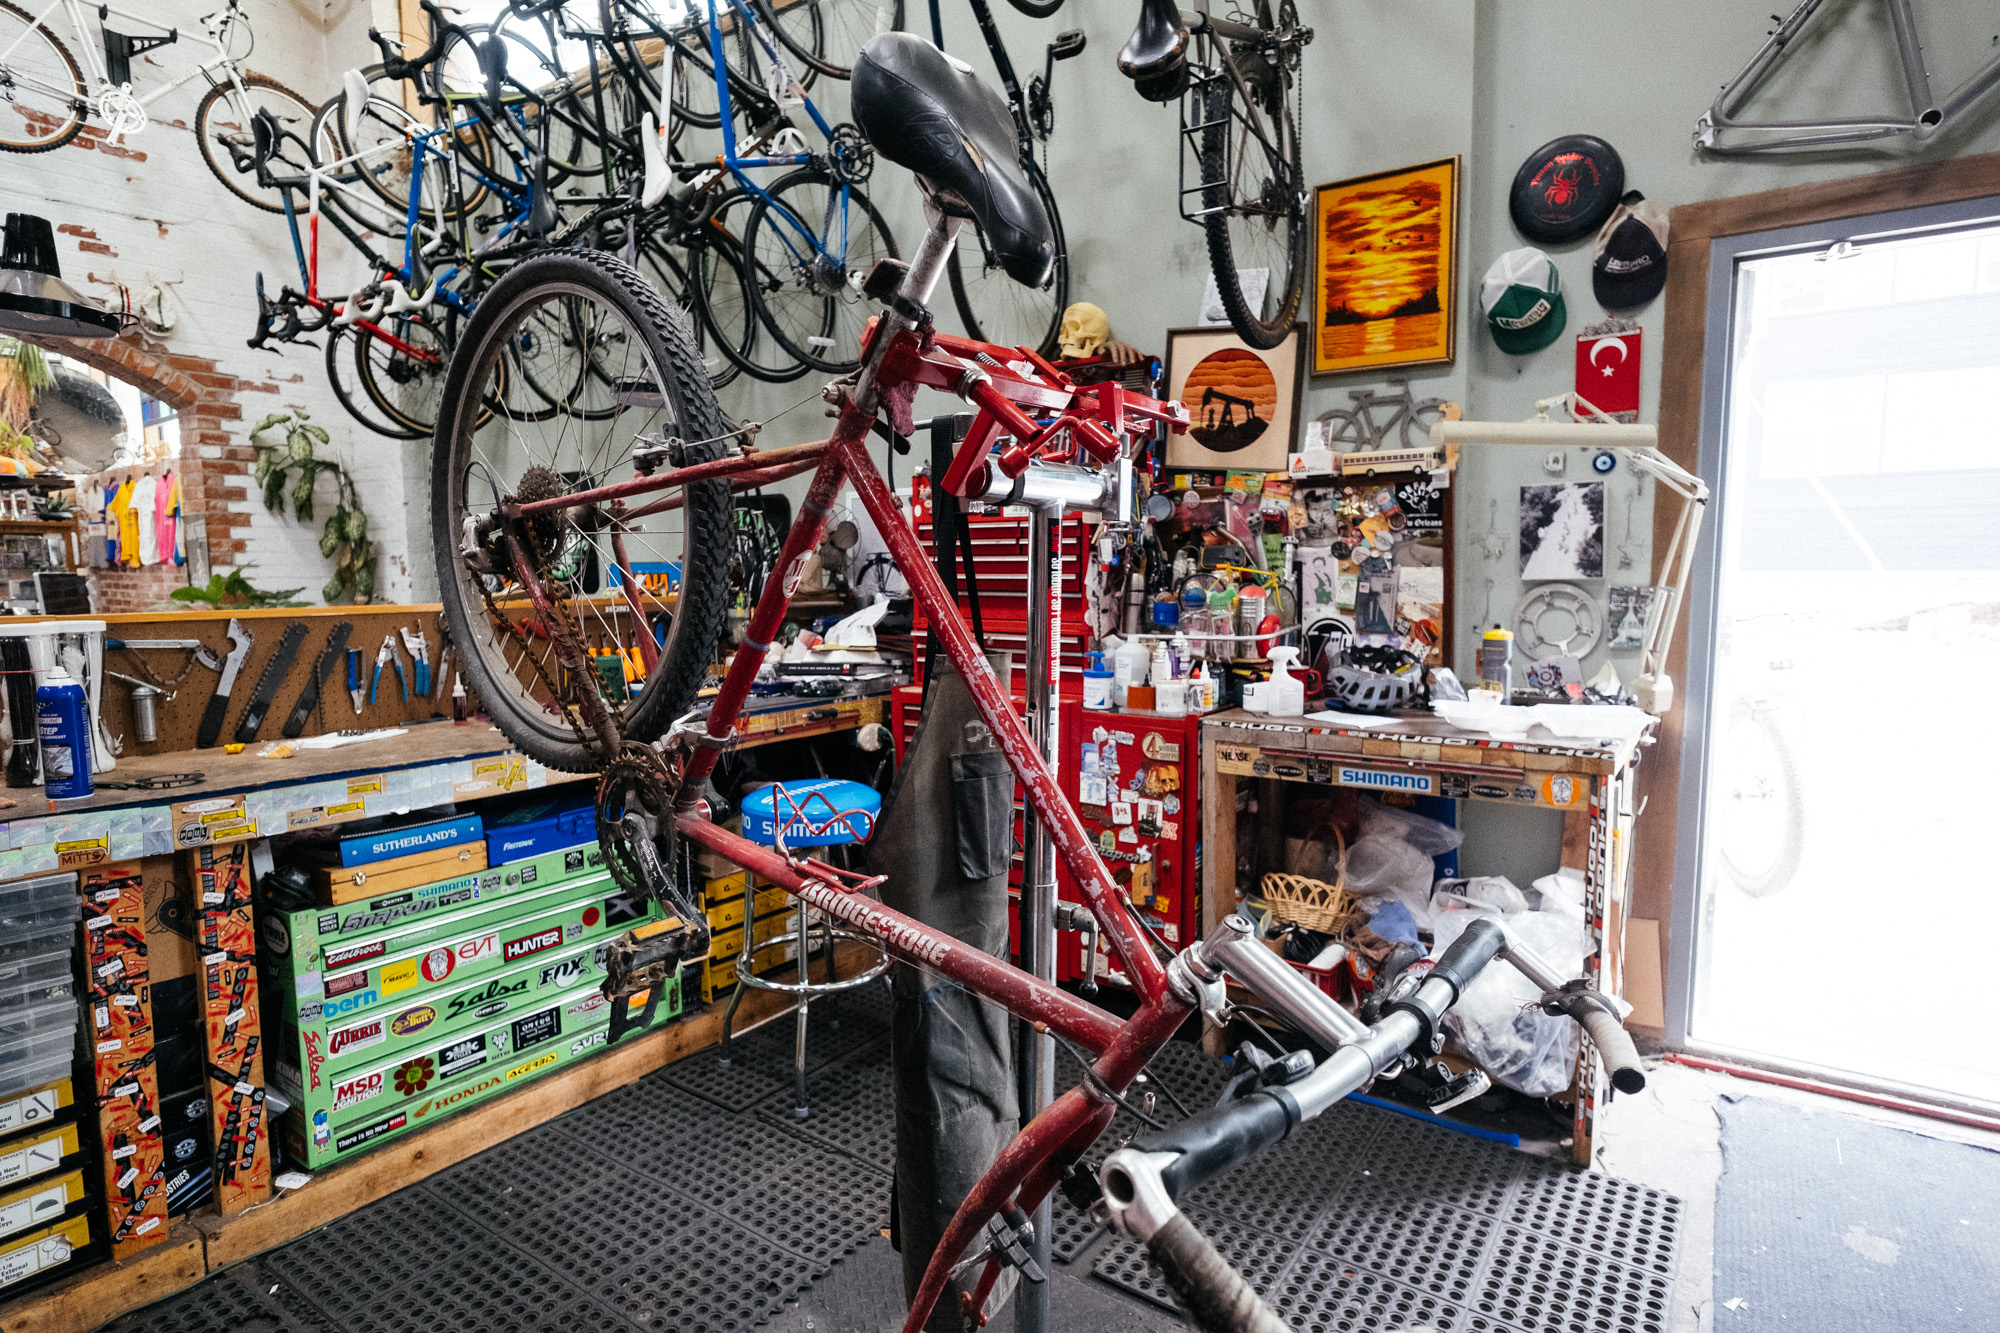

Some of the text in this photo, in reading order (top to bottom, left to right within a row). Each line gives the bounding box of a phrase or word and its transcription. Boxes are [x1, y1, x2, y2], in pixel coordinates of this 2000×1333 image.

[1530, 161, 1554, 187] Poison
[1554, 152, 1584, 164] Spider
[1414, 518, 1443, 527] Orleans
[40, 726, 59, 736] STEP
[1229, 721, 1304, 733] HUGO
[1378, 733, 1468, 746] HUGO
[1342, 769, 1430, 790] SHIMANO
[179, 828, 207, 842] PAUL
[372, 827, 458, 855] SUTHERLAND'S
[1586, 825, 1597, 917] HUGO
[1596, 817, 1607, 910] HUGO
[418, 879, 471, 899] SHIMANO
[320, 920, 338, 928] WRENCH
[320, 925, 338, 933] CYCLES
[799, 876, 951, 967] BRIDGESTONE
[327, 942, 384, 965] Edelbrock
[458, 935, 497, 959] EVT
[507, 931, 560, 958] HUNTER
[388, 972, 411, 982] MAVIC
[539, 955, 588, 987] FOX
[324, 990, 378, 1018] bern
[445, 978, 529, 1021] Salsa
[329, 1021, 382, 1054] CURRIE
[301, 1031, 326, 1094] Salsa
[337, 1073, 382, 1101] MSD
[338, 1087, 379, 1107] IGNITION
[435, 1077, 501, 1110] HONDA
[337, 1115, 406, 1149] There is No New BIKE
[0, 1172, 19, 1181] crews
[3, 1164, 20, 1175] Head
[0, 1219, 13, 1229] eys
[1, 1262, 28, 1277] External
[5, 1270, 24, 1281] Rings
